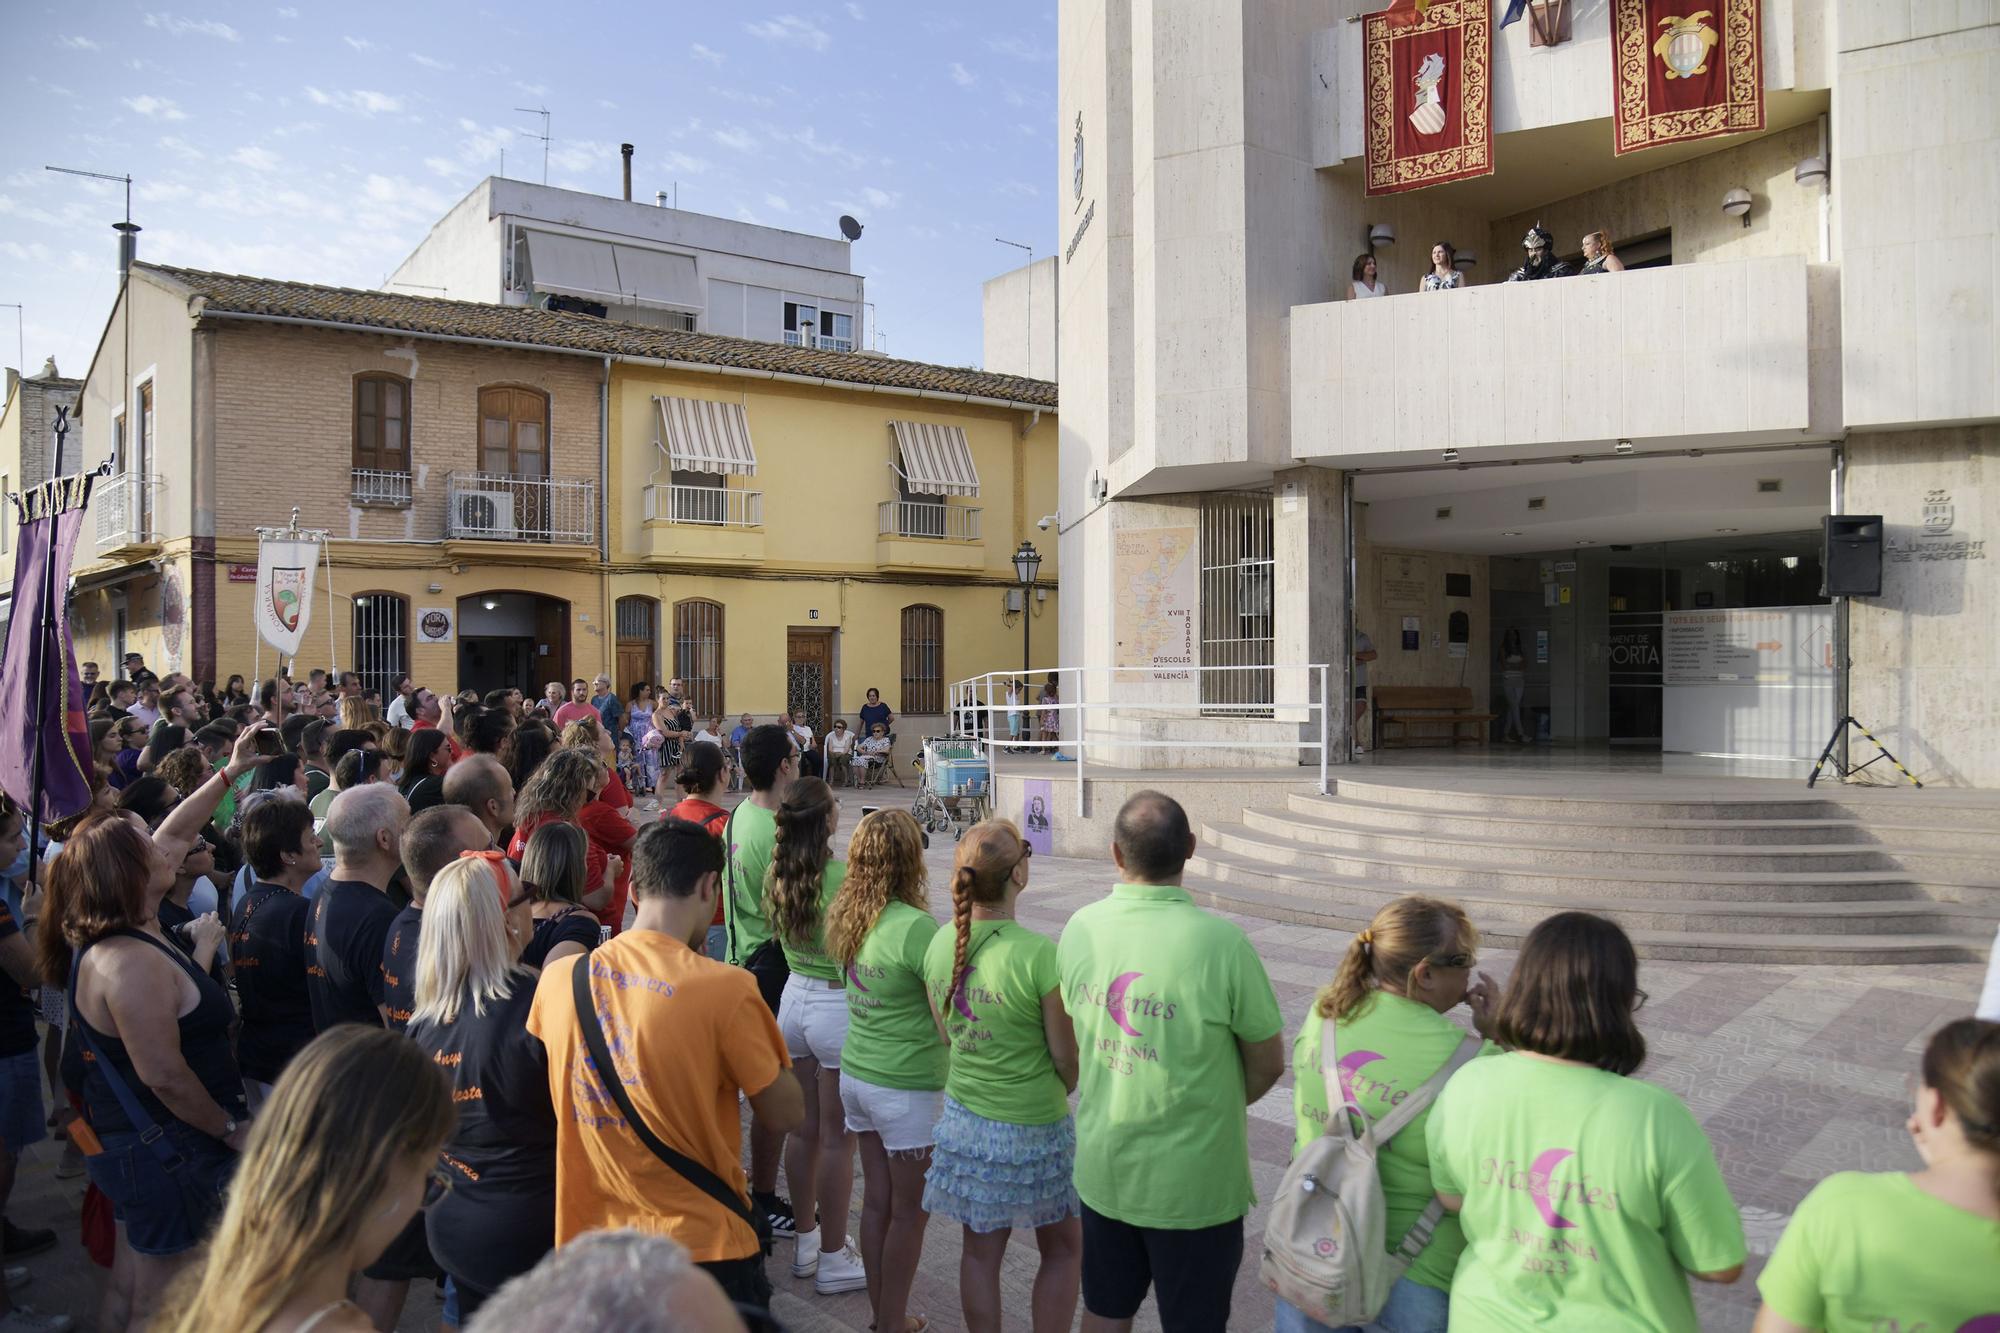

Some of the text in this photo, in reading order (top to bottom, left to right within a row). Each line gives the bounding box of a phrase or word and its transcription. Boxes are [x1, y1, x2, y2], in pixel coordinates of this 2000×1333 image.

[264, 584, 286, 633] COMPARSA
[810, 610, 818, 619] 10
[425, 612, 446, 624] VORA
